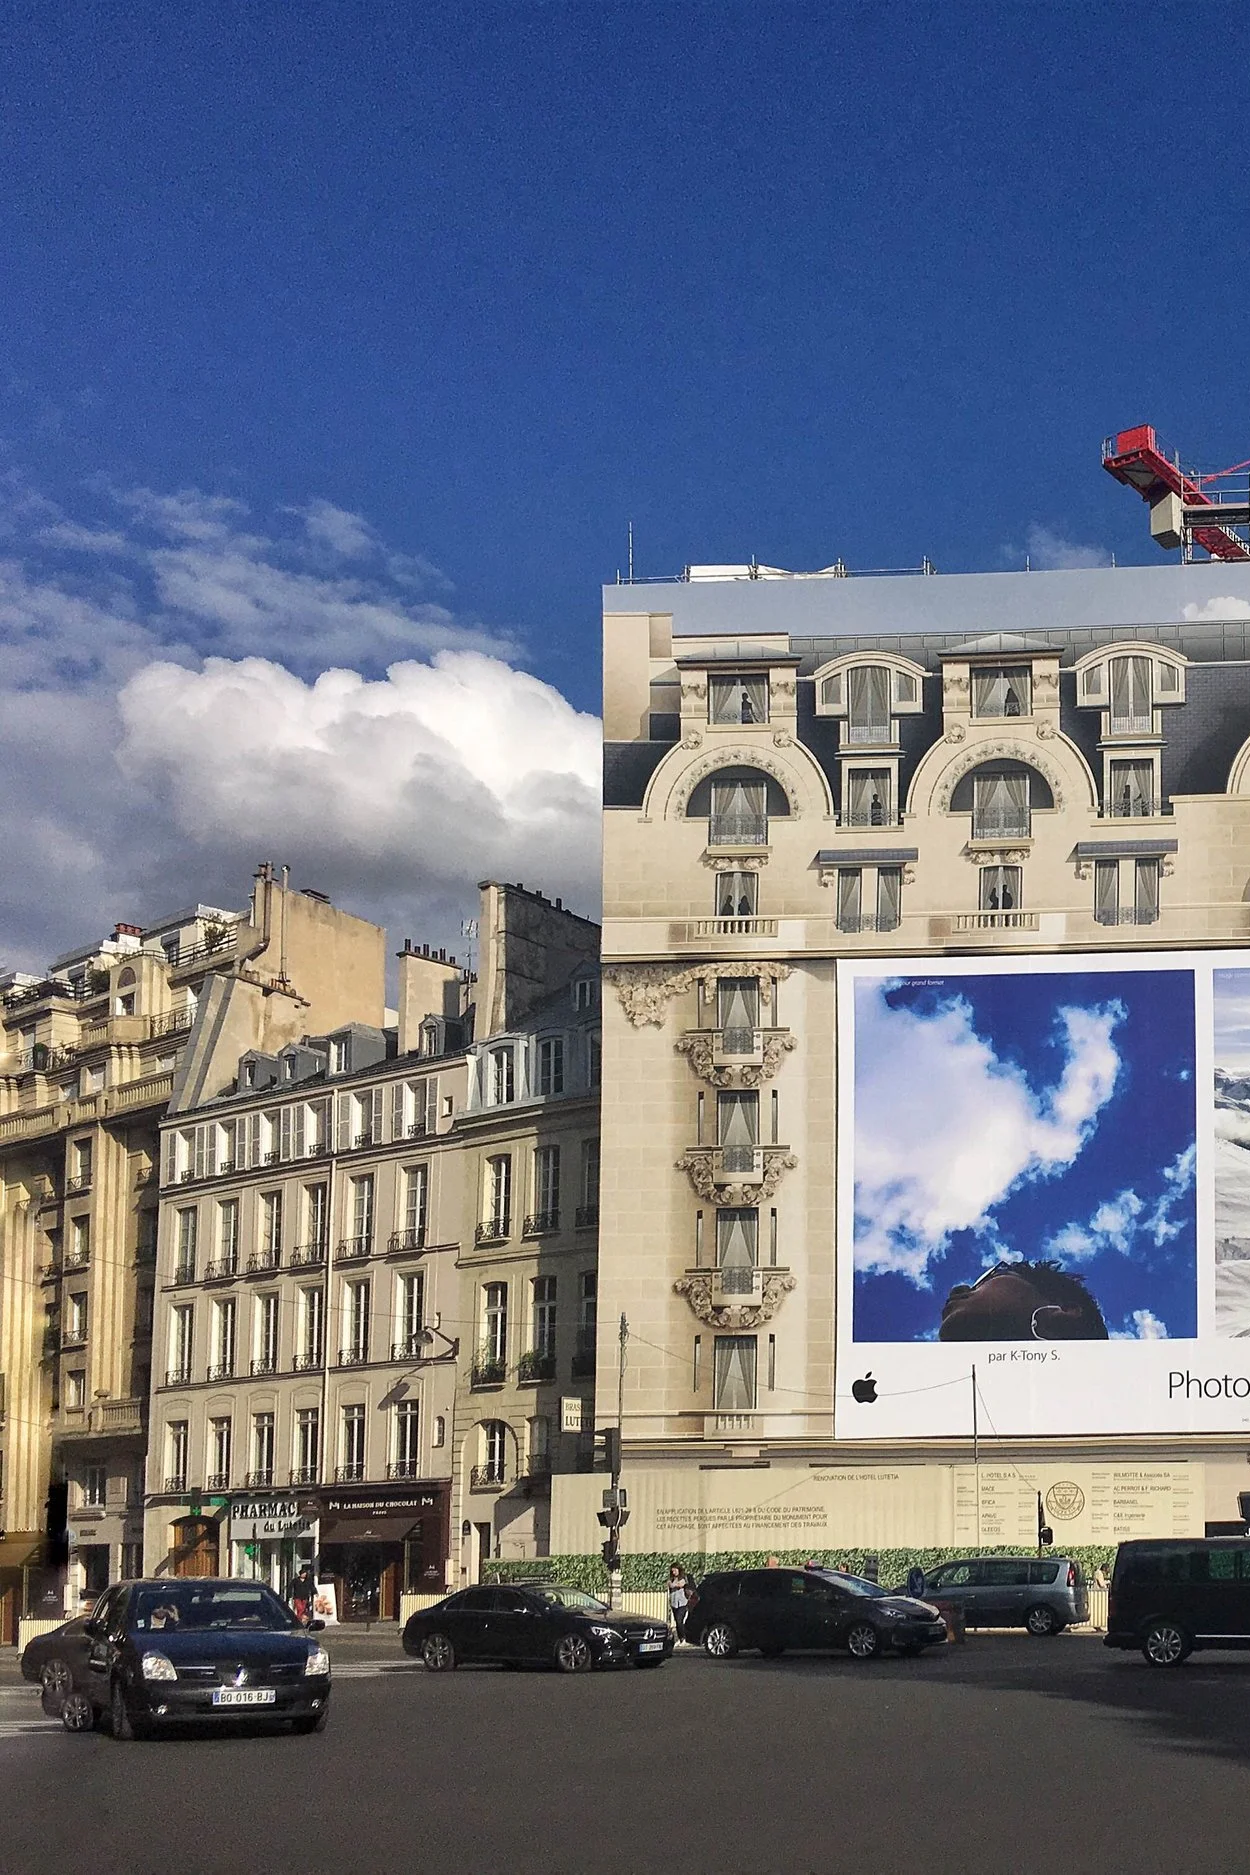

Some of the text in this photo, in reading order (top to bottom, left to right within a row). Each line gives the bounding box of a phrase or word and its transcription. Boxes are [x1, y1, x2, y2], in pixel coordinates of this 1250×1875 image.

[988, 1349, 1061, 1364] par K-Tony S.
[232, 1502, 300, 1519] PHARMACI
[385, 1500, 418, 1508] CHOCOLAT
[264, 1520, 275, 1532] du
